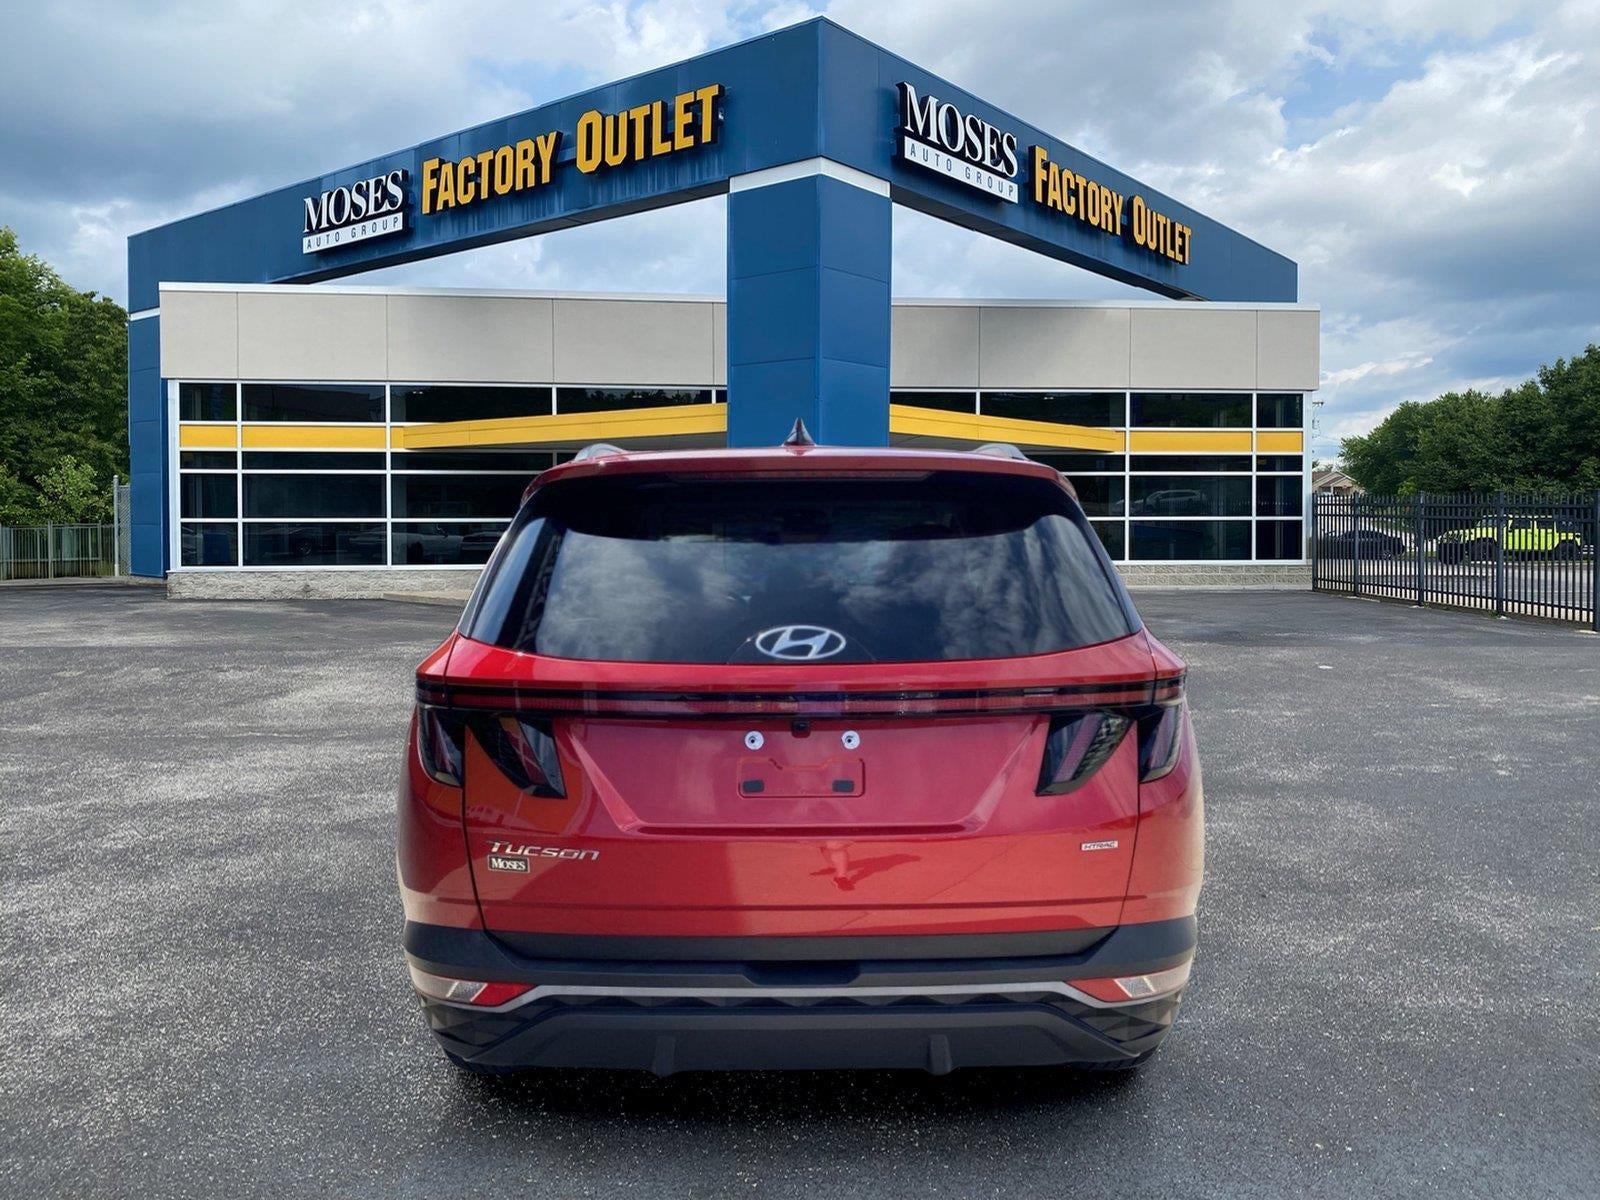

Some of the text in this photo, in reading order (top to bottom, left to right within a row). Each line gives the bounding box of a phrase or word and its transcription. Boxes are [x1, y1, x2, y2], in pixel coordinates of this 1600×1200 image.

[422, 83, 719, 215] FACTORY OUTLET
[904, 82, 1018, 178] MOSES
[910, 143, 1014, 197] AUTO GROUP
[303, 169, 403, 233] MOSES
[1035, 145, 1192, 265] FACTORY OUTLET
[306, 216, 399, 250] AUTO GROUP
[486, 840, 600, 860] TUCSON
[491, 858, 526, 871] MOSES
